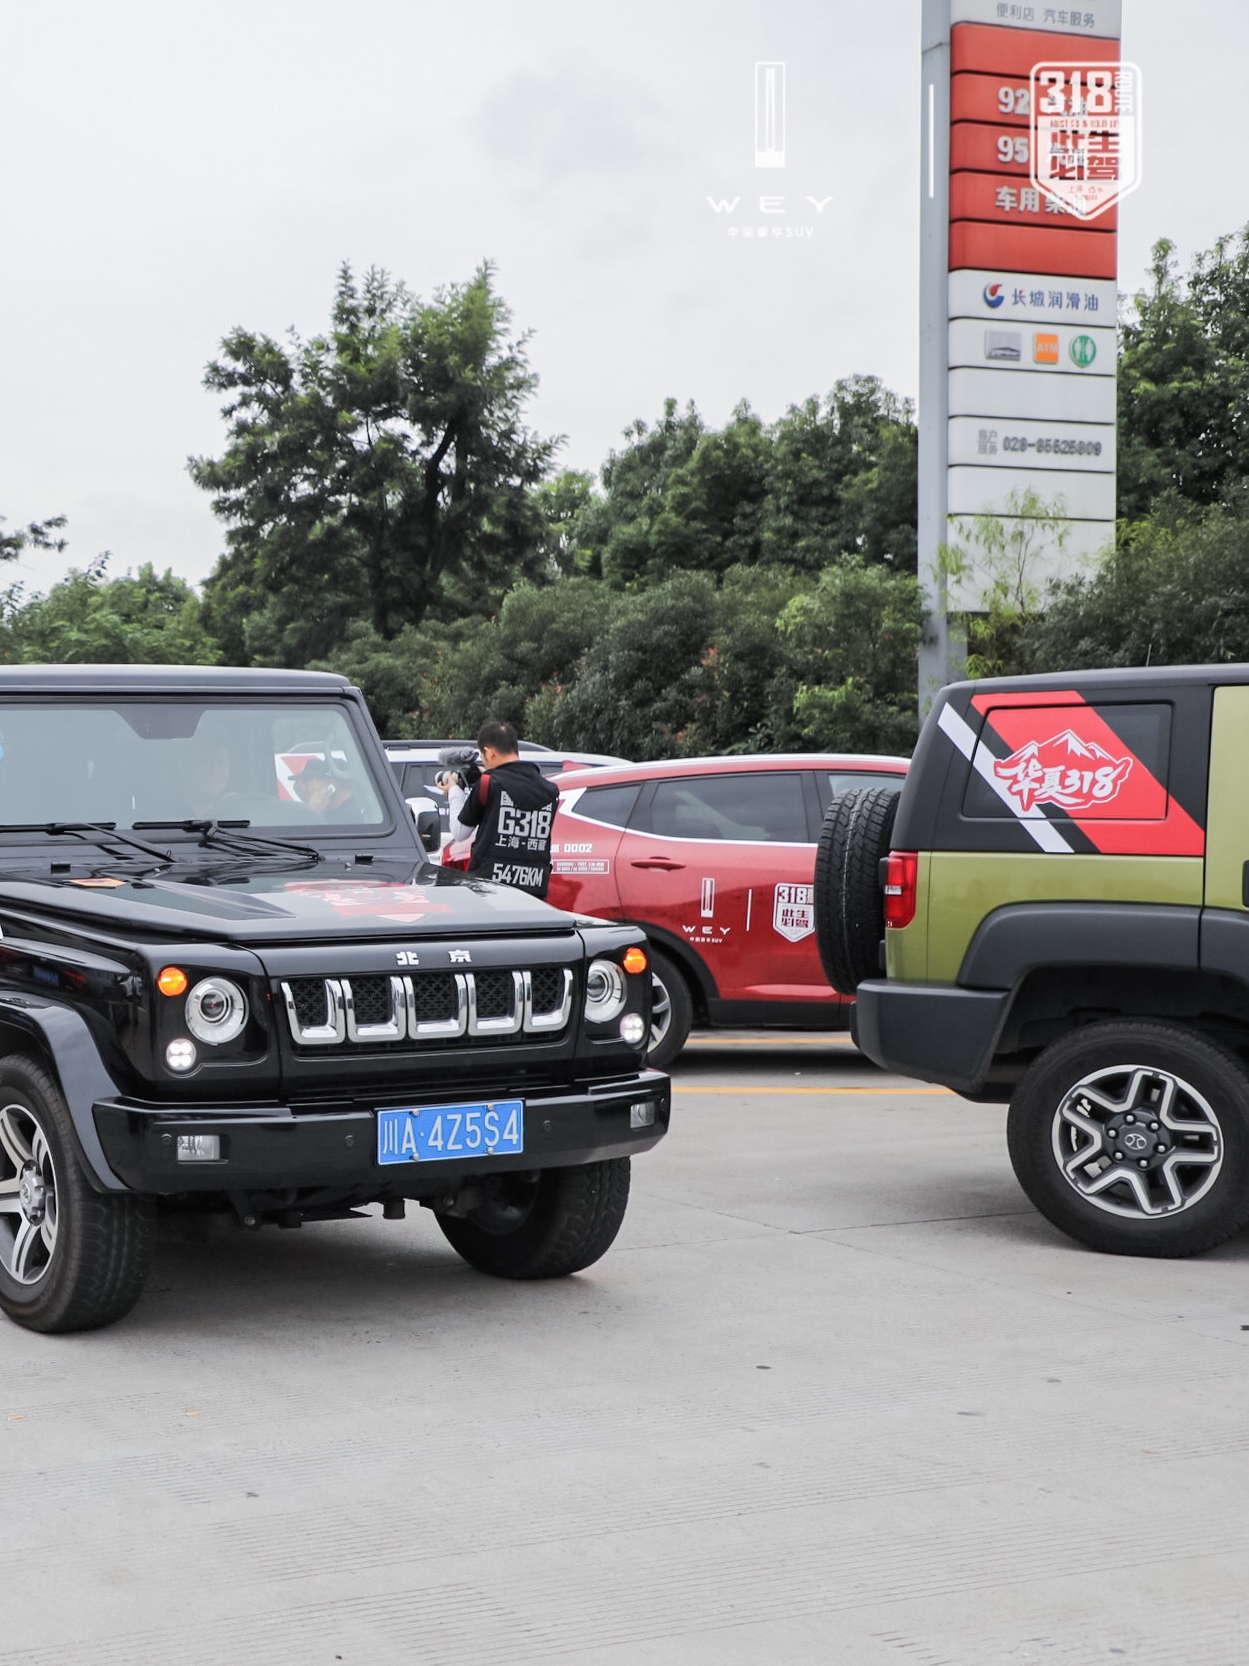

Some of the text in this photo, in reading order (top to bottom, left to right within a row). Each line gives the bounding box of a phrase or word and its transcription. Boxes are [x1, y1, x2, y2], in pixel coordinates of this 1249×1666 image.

[997, 3, 1095, 28] 便利店 汽车服务
[998, 86, 1030, 115] 92
[997, 136, 1029, 164] 95
[1011, 287, 1099, 312] 长城润滑油
[1037, 341, 1059, 353] ATM
[996, 758, 1127, 806] 华夏318
[497, 806, 552, 838] G318
[564, 843, 593, 853] 0002
[491, 862, 544, 888] 5476KM
[778, 886, 807, 904] 318
[682, 924, 731, 936] WEY
[396, 949, 472, 966] 北京
[382, 1108, 520, 1157] 川A·4Z5S4
